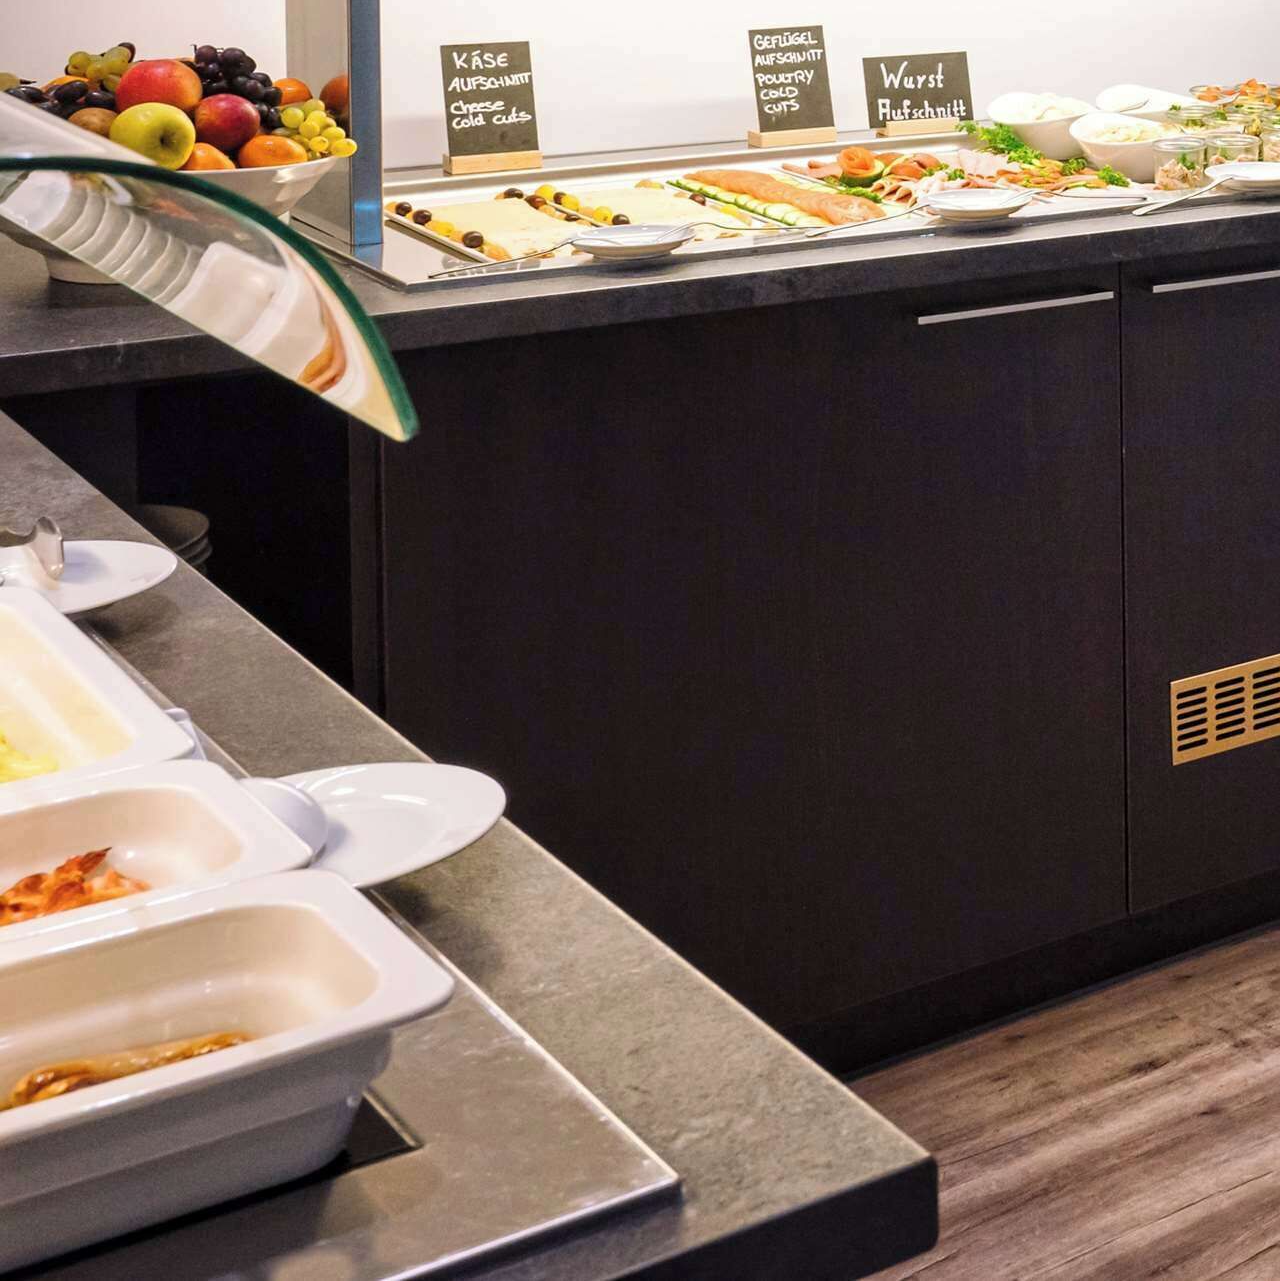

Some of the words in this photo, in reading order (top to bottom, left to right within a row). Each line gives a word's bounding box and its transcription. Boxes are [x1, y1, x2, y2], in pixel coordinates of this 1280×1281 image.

[754, 49, 824, 67] AUFSCHNITT
[447, 71, 532, 93] AUFSCHNITT
[755, 69, 815, 87] POULTRY
[879, 60, 945, 89] Wurst
[877, 99, 967, 121] Aufschnitt
